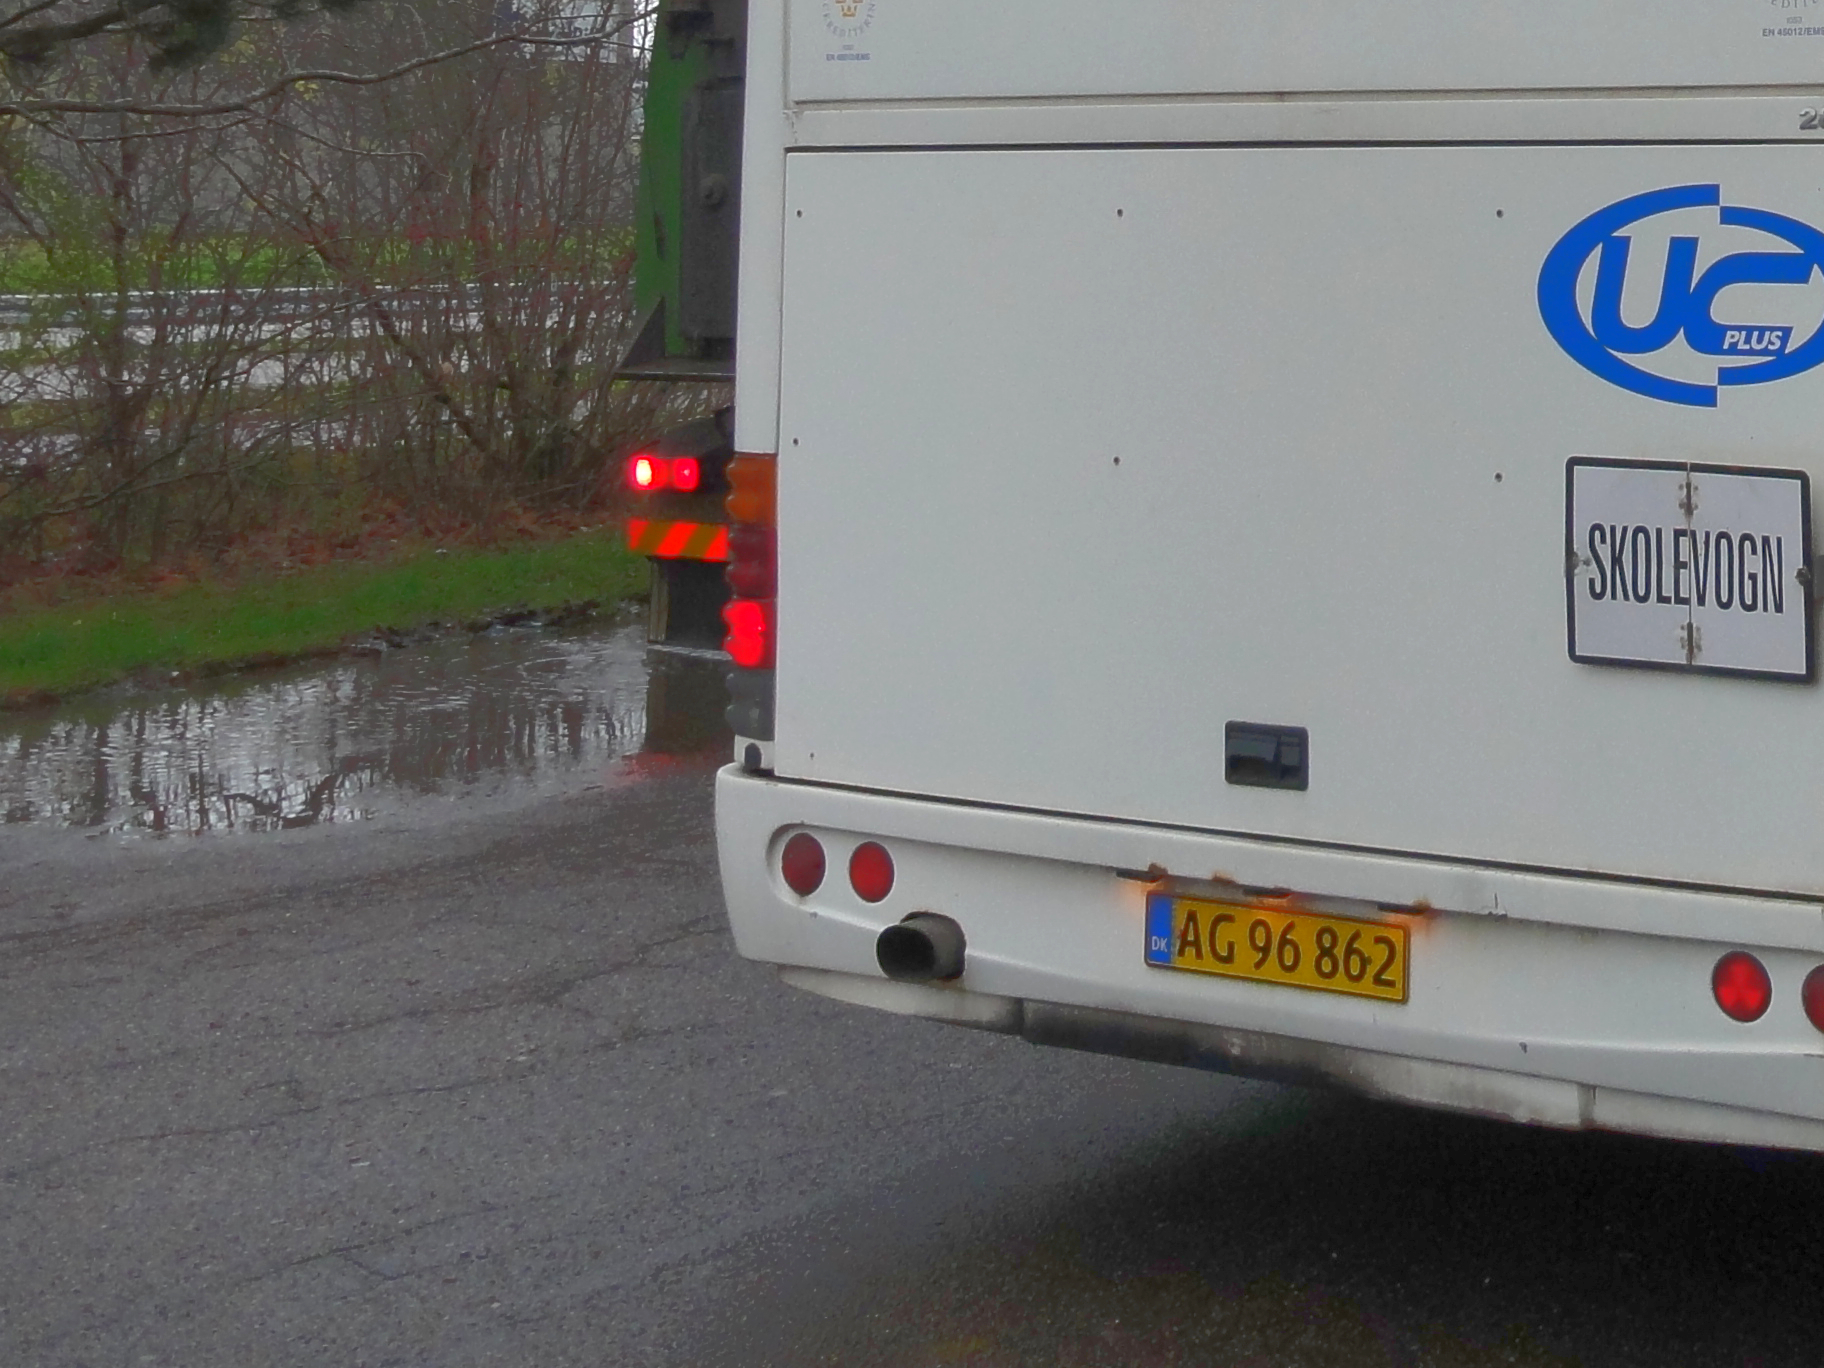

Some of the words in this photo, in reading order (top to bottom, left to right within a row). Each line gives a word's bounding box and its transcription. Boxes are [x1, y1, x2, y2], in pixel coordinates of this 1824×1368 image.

[1590, 234, 1816, 357] UC
[1722, 329, 1783, 351] PLUS
[1587, 522, 1785, 614] SKOLEVOGN
[1151, 935, 1169, 953] DK
[1177, 909, 1236, 965] AG
[1248, 918, 1302, 974] 96
[1313, 925, 1398, 989] 862
